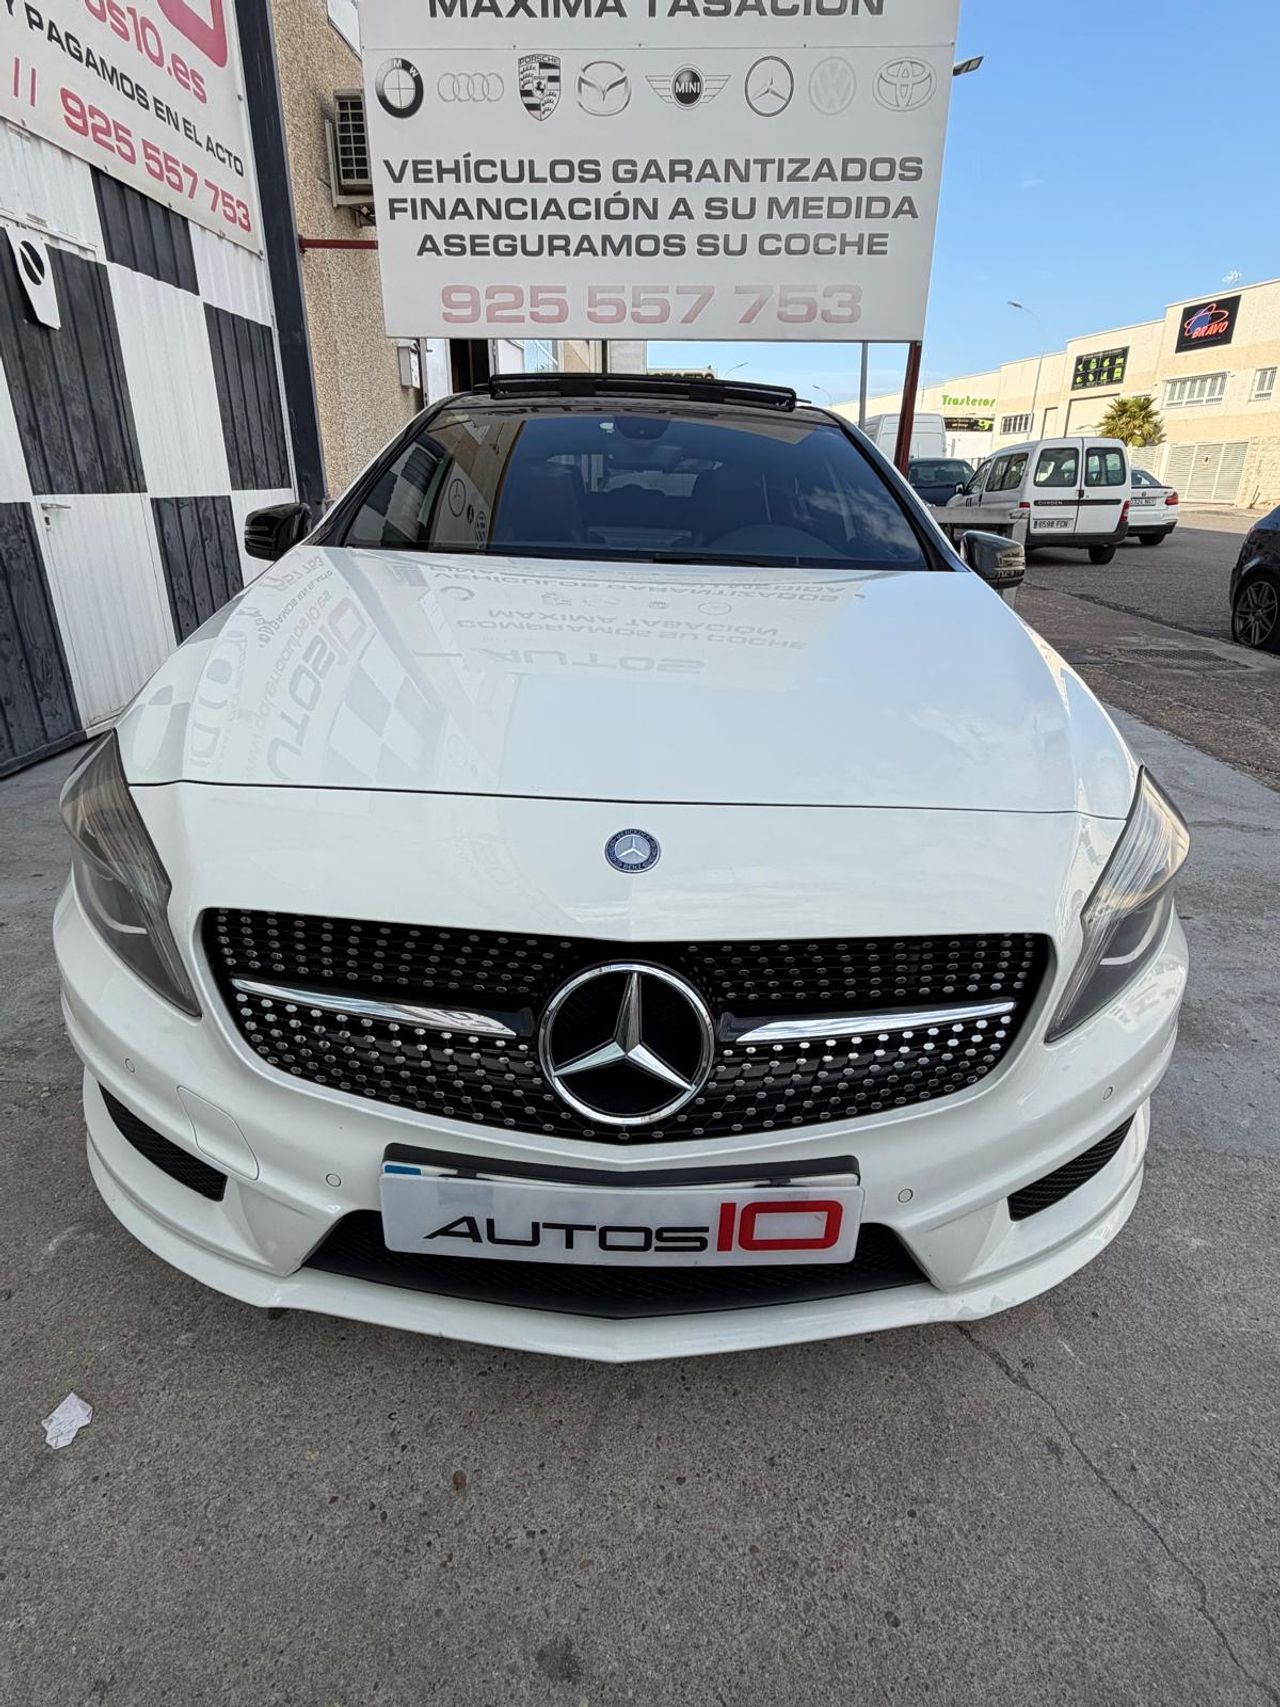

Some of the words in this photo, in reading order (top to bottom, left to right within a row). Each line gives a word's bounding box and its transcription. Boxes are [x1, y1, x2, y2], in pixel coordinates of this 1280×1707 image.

[25, 3, 150, 111] PAGAMOS
[152, 95, 180, 132] EN
[182, 117, 203, 148] EL
[206, 135, 244, 177] ACTO
[676, 81, 700, 94] MINI
[60, 87, 136, 165] 925
[142, 138, 198, 200] 557
[204, 179, 251, 232] 753
[383, 152, 601, 184] VEHÍCULOS
[612, 157, 923, 183] GARANTIZADOS
[388, 190, 659, 220] FINANCIACIÓN
[668, 197, 695, 220] A
[704, 197, 756, 220] SU
[767, 196, 919, 220] MEDIDA
[417, 234, 686, 257] ASEGURAMOS
[696, 233, 747, 257] SU
[758, 233, 889, 256] COCHE
[441, 285, 569, 324] 925
[586, 285, 715, 324] 557
[734, 285, 863, 324] 753
[1191, 321, 1229, 339] BRAVO
[942, 394, 996, 407] Trasteros
[423, 1199, 844, 1253] AUTOS10
